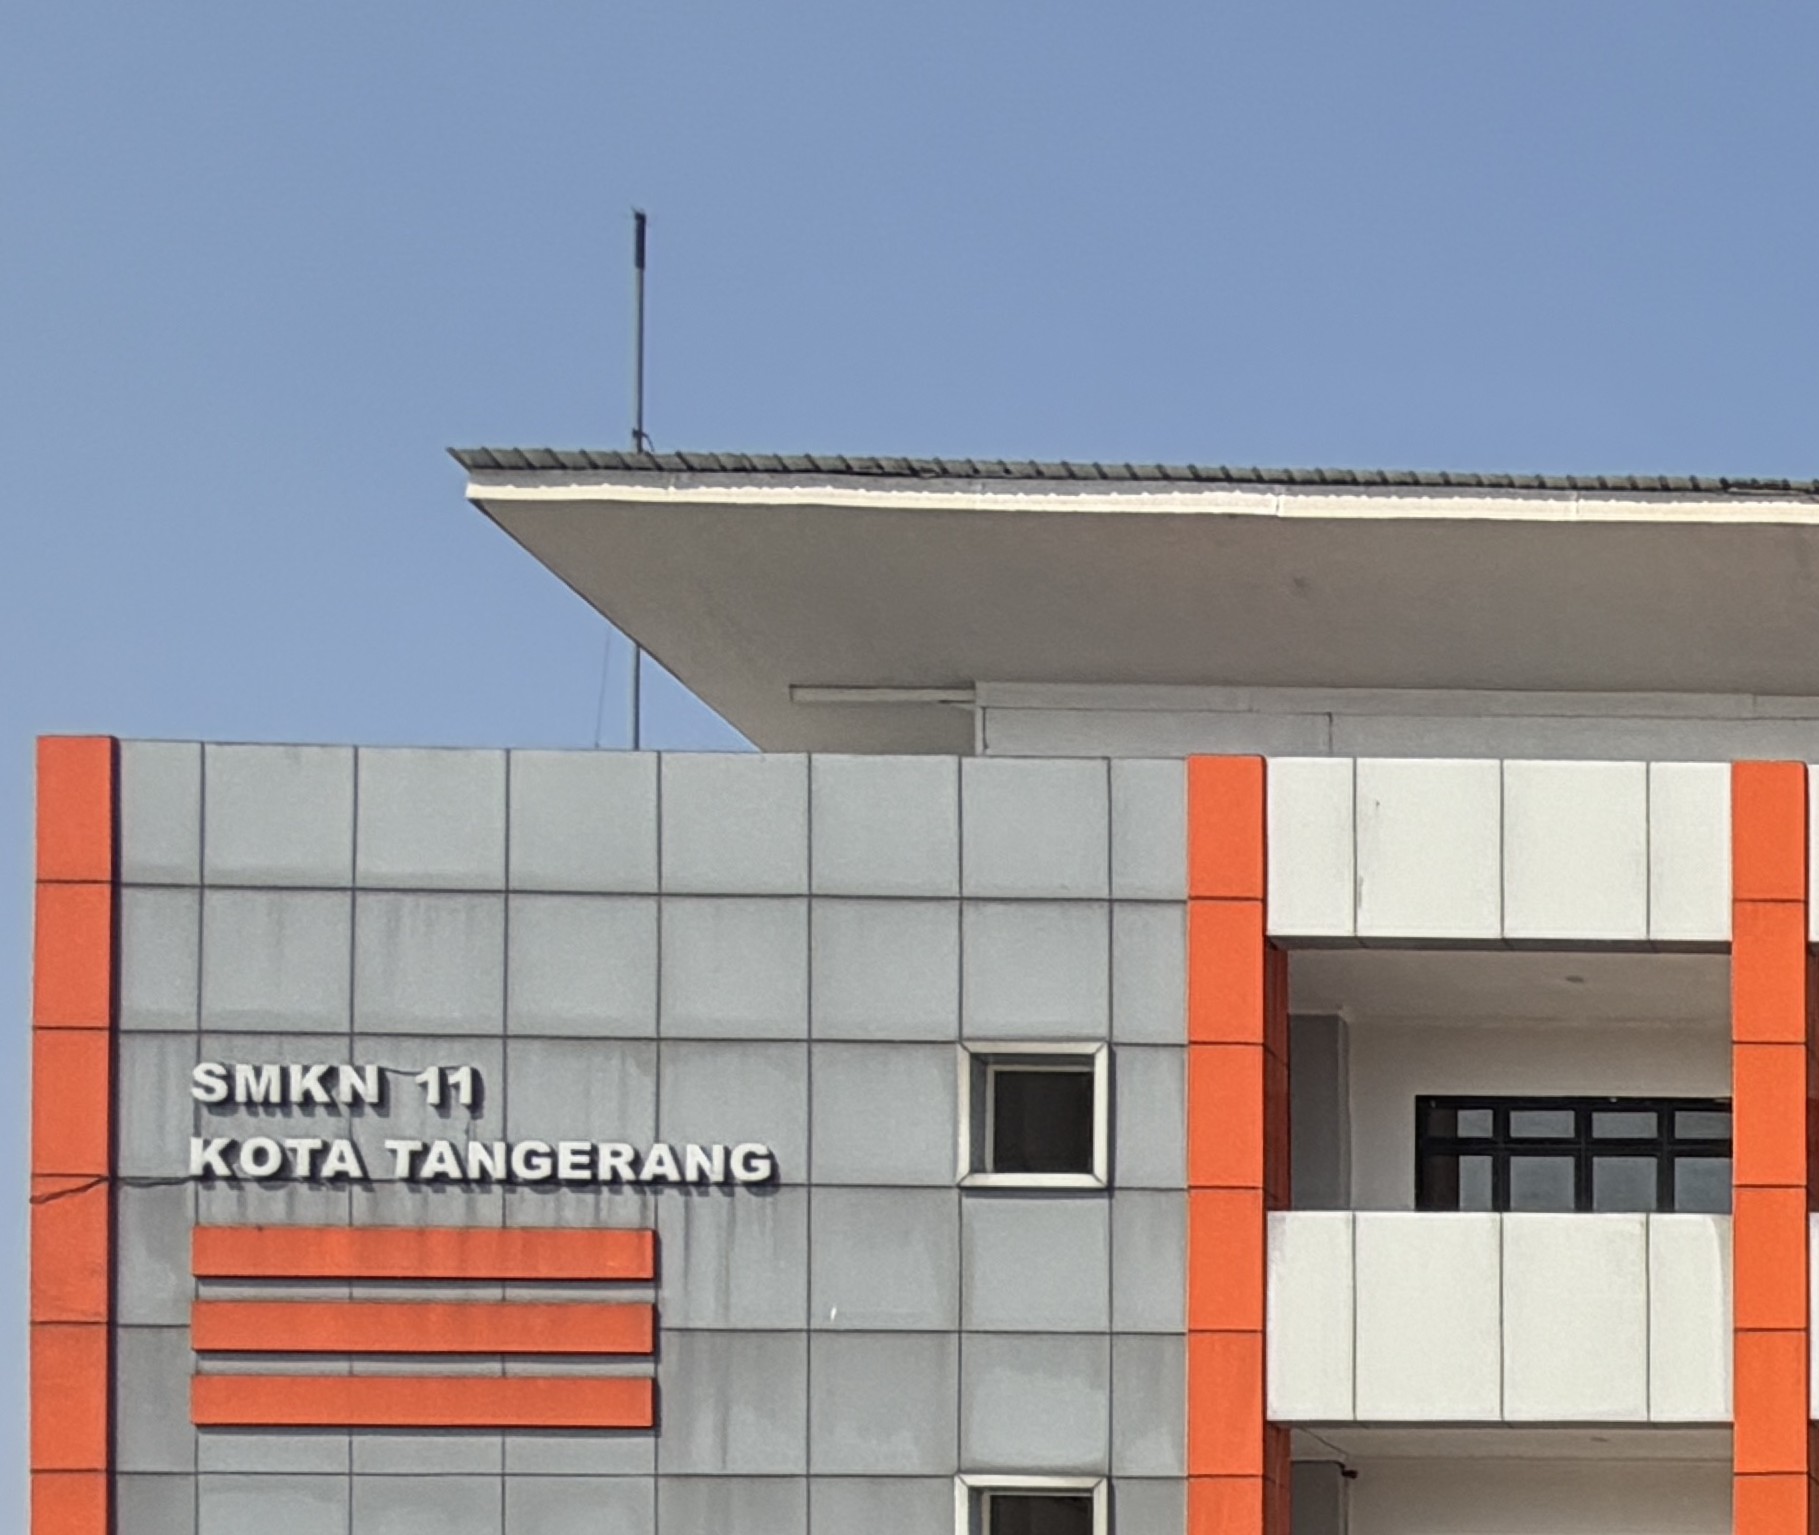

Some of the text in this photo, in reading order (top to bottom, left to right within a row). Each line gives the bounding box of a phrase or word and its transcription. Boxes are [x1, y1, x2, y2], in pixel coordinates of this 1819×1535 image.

[190, 1061, 473, 1105] SMKN 11
[189, 1136, 773, 1184] KOTA TANGERANG
